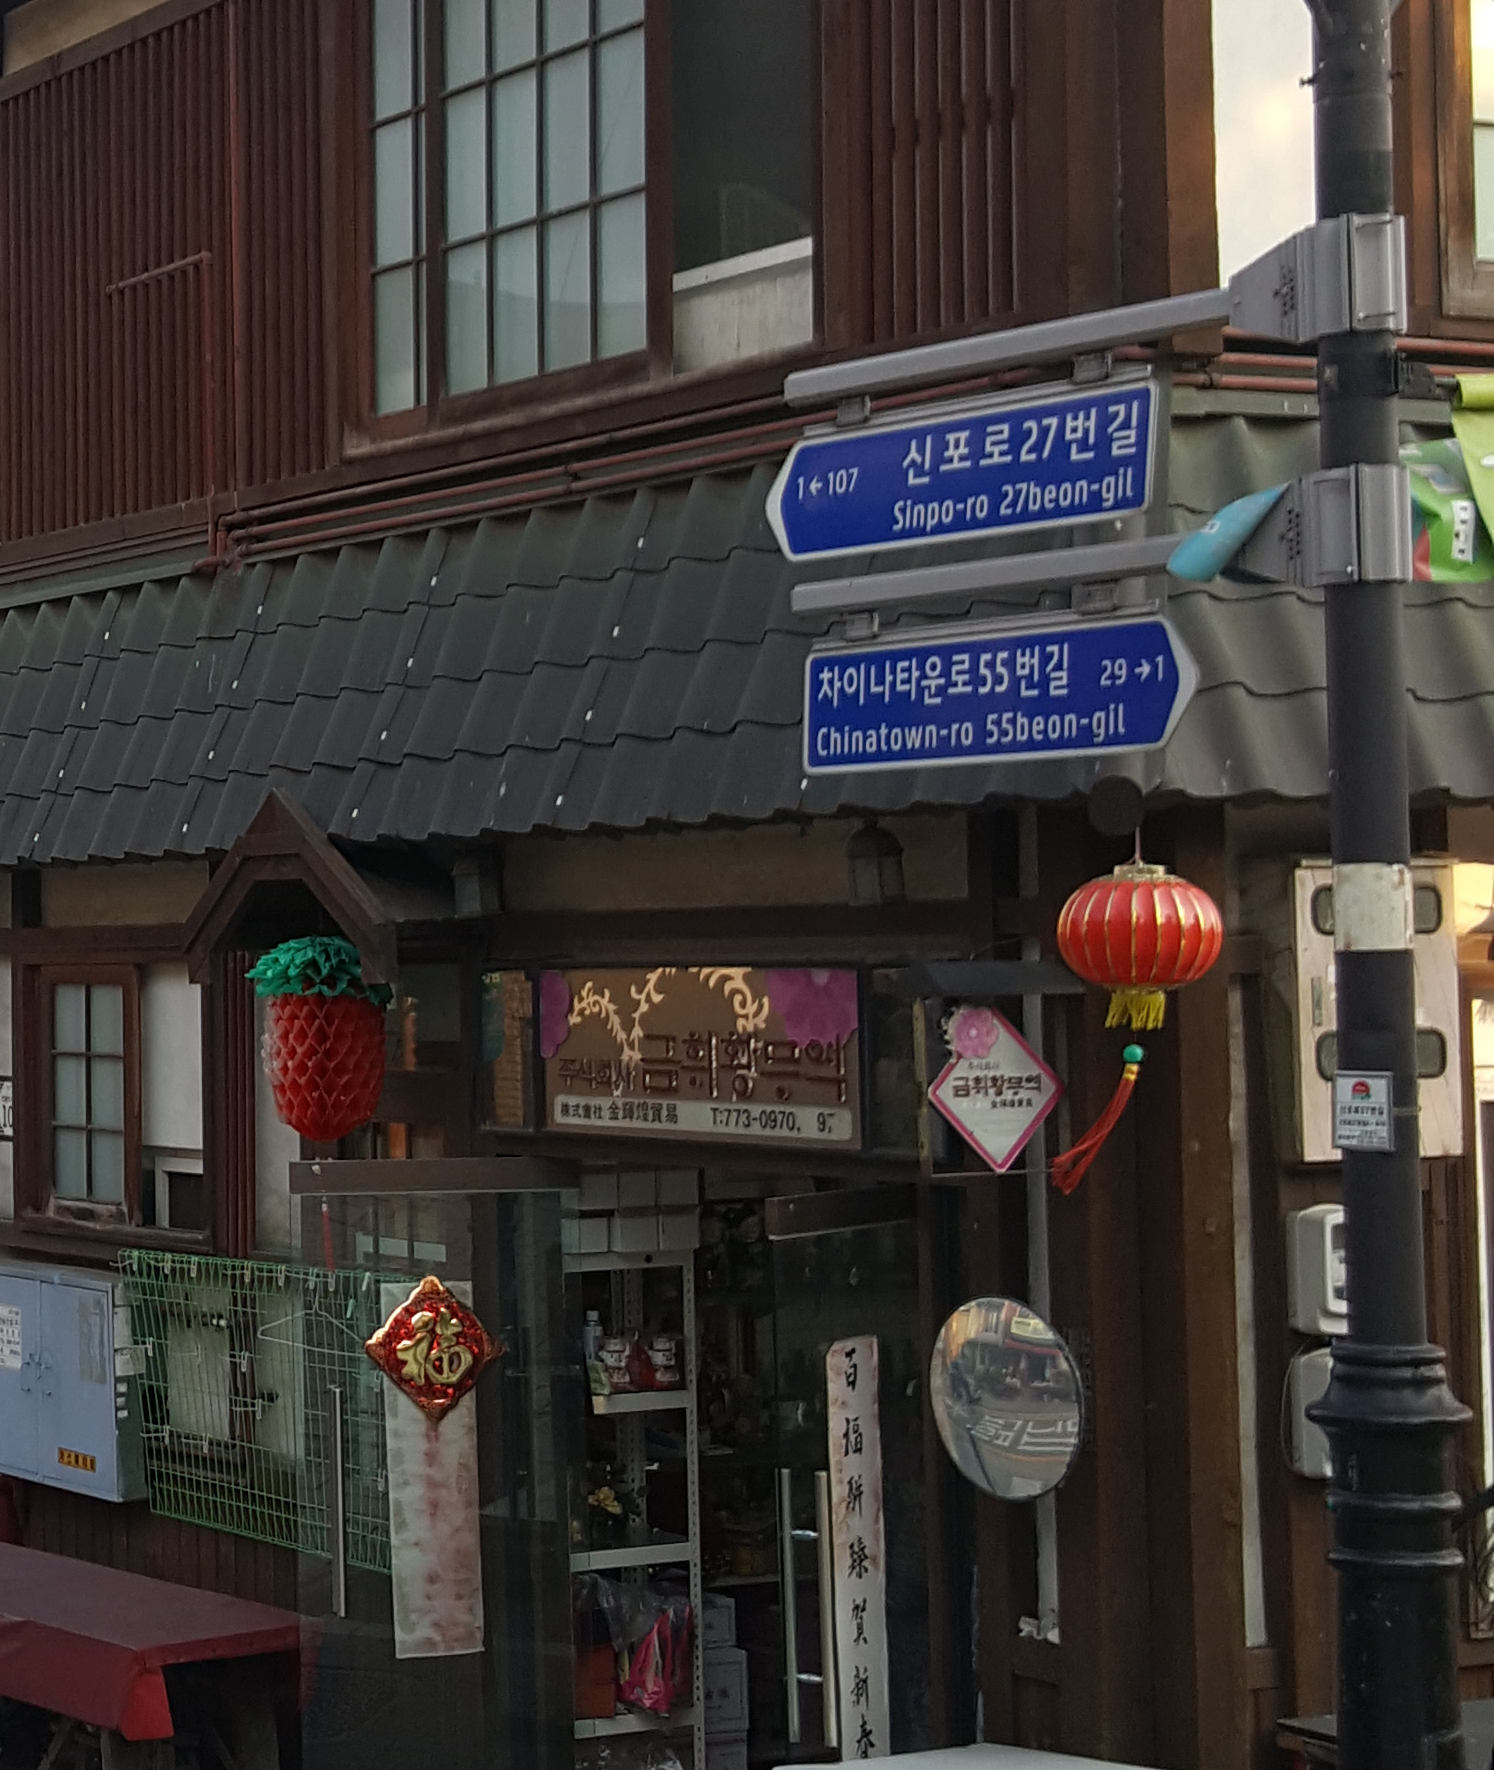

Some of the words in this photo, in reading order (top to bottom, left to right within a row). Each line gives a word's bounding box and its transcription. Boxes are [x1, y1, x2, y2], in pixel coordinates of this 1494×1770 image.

[902, 399, 1141, 486] 신포로27번길
[826, 466, 859, 496] 107
[892, 493, 988, 533] Sinpo-ro
[1000, 467, 1134, 517] 27beon-gil
[817, 641, 1069, 708] 차이나타운로55번길
[1099, 657, 1127, 686] 29
[816, 719, 974, 757] Chinatown-ro
[985, 702, 1126, 744] 55beon-gil
[952, 1073, 1042, 1098] 금휘황무역
[395, 1306, 474, 1386] 福
